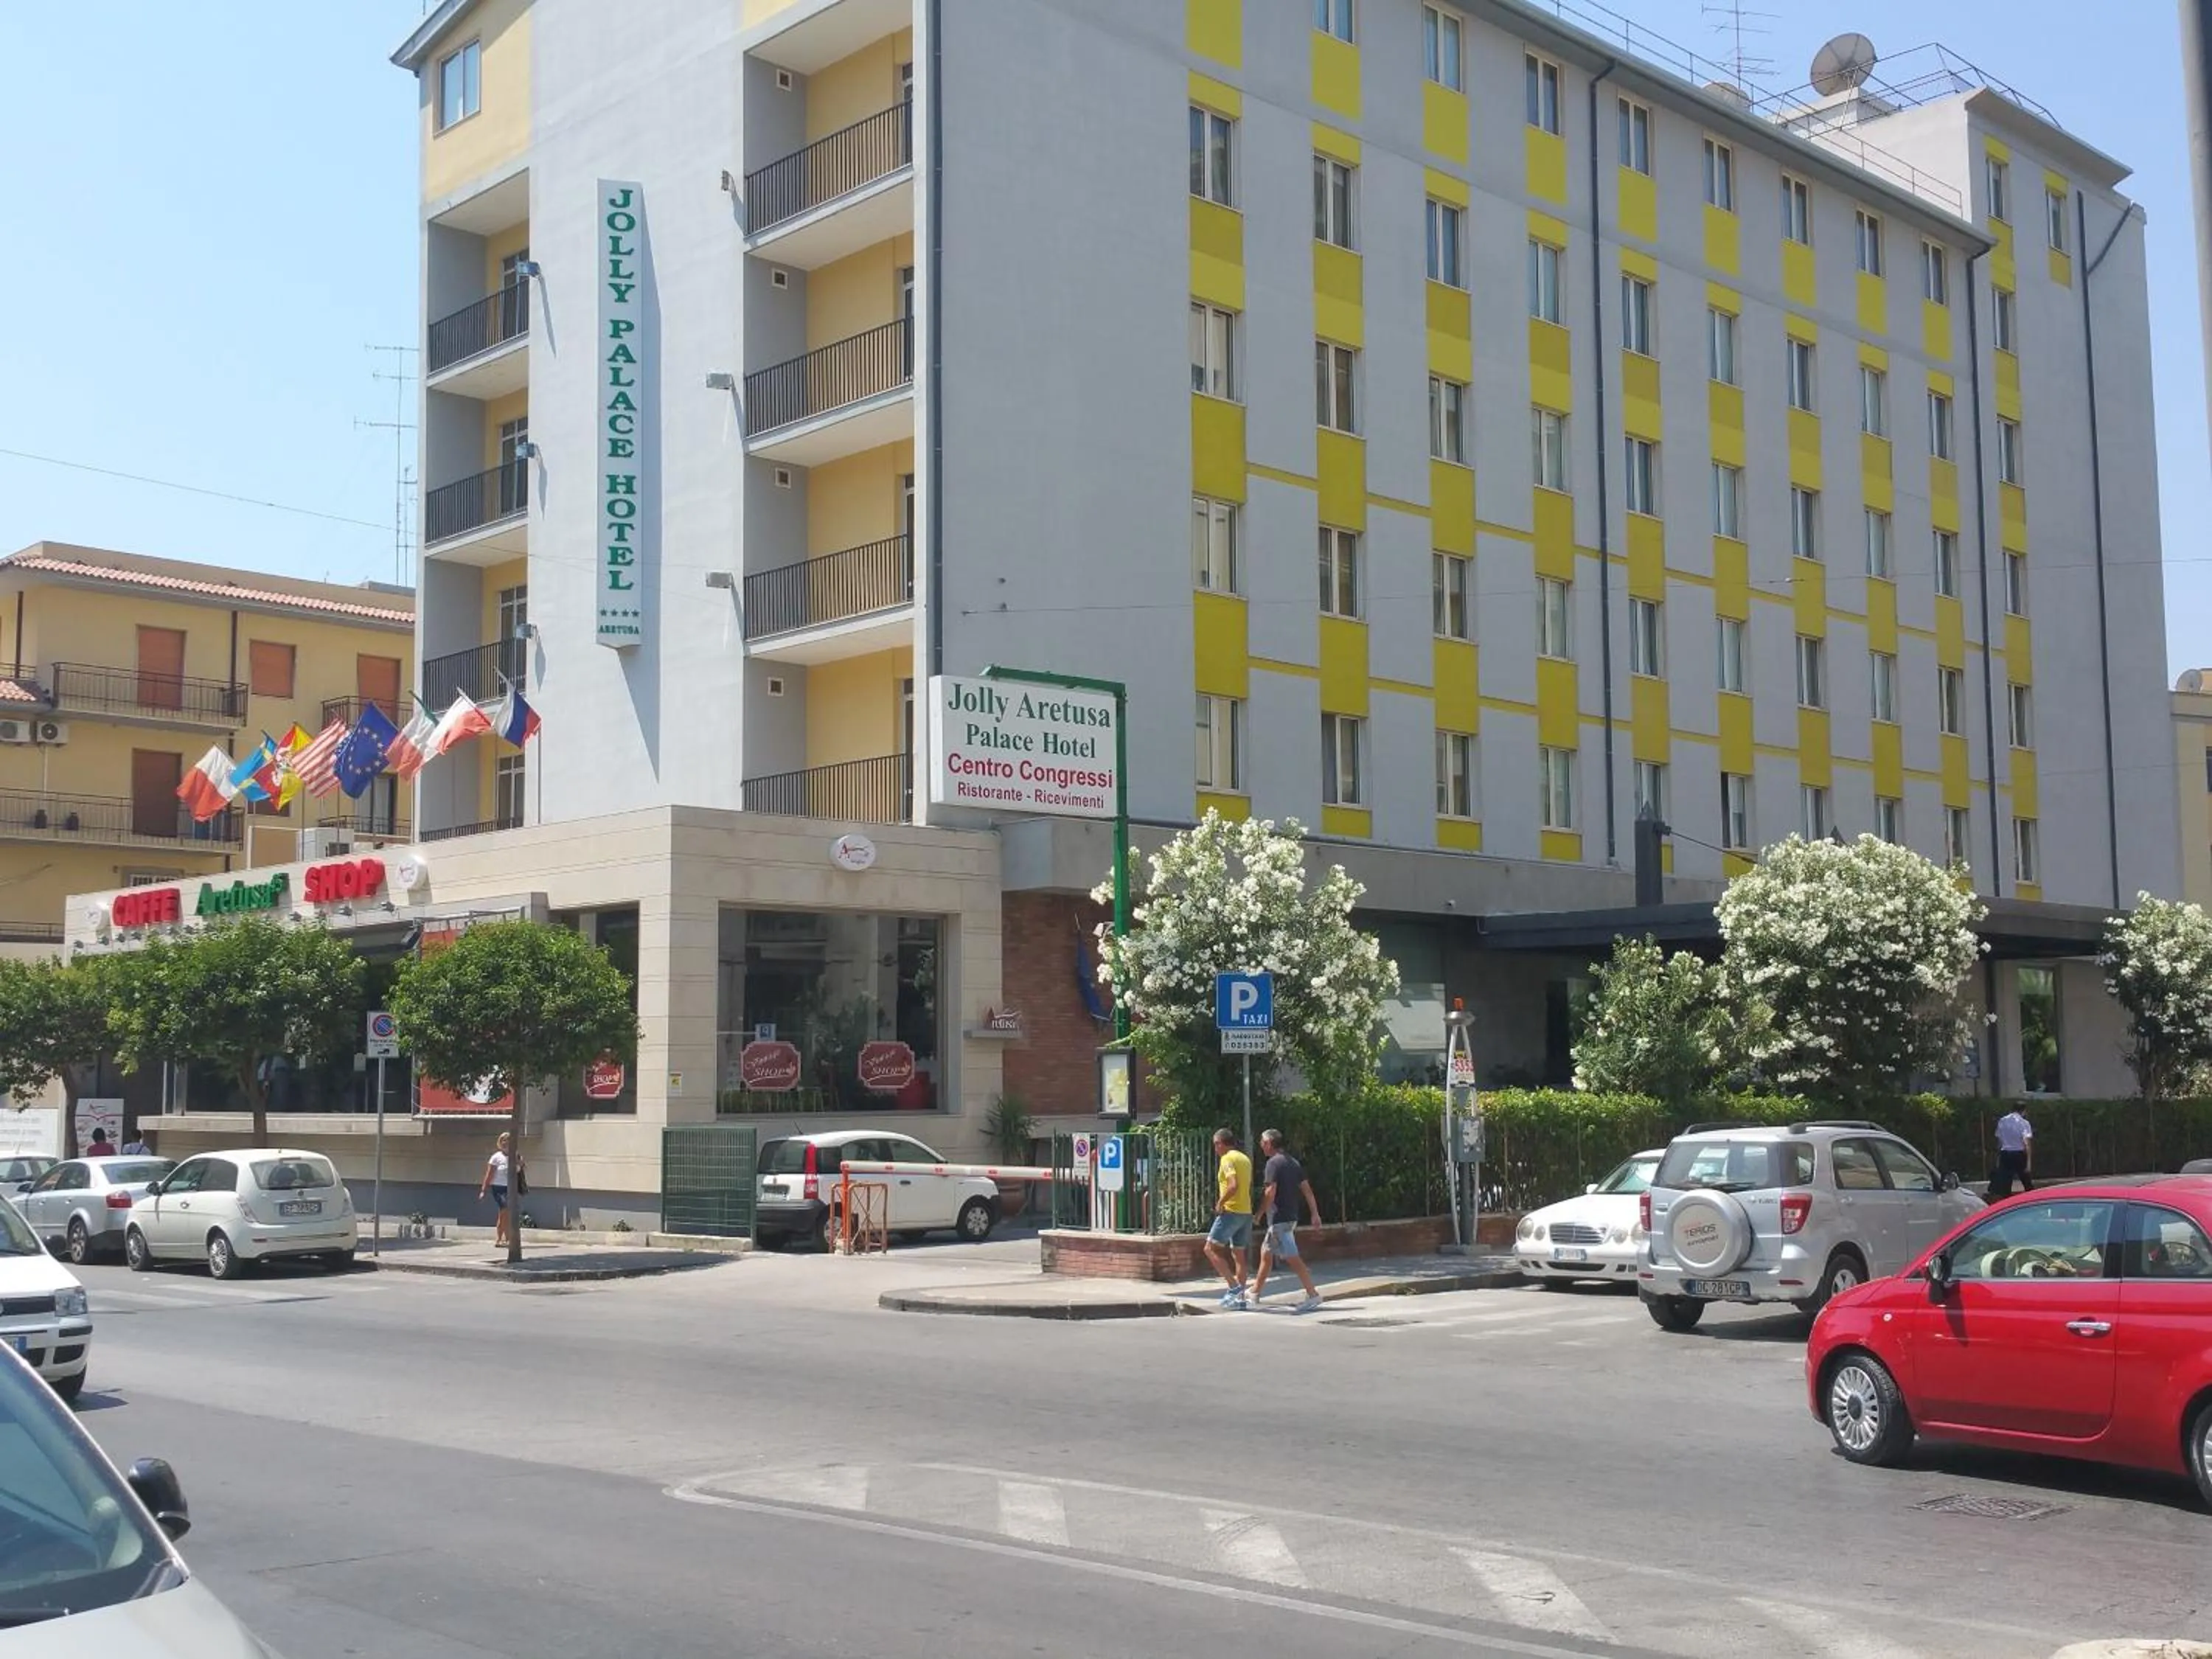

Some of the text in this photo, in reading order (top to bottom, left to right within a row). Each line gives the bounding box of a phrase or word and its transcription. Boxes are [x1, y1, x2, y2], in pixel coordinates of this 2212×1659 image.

[606, 189, 636, 591] JOLLY PALACE HOTEL
[598, 625, 639, 635] ARETUSA
[947, 683, 1111, 728] Jolly Aretusa
[965, 723, 1096, 759] Palace Hotel
[948, 753, 1113, 789] Centro Congressi
[958, 782, 1023, 802] Ristorante
[1034, 789, 1105, 810] Ricevimenti
[304, 858, 386, 902] SHOP
[1231, 981, 1259, 1022] P
[1243, 1014, 1268, 1025] TAXI
[1105, 1143, 1117, 1166] P
